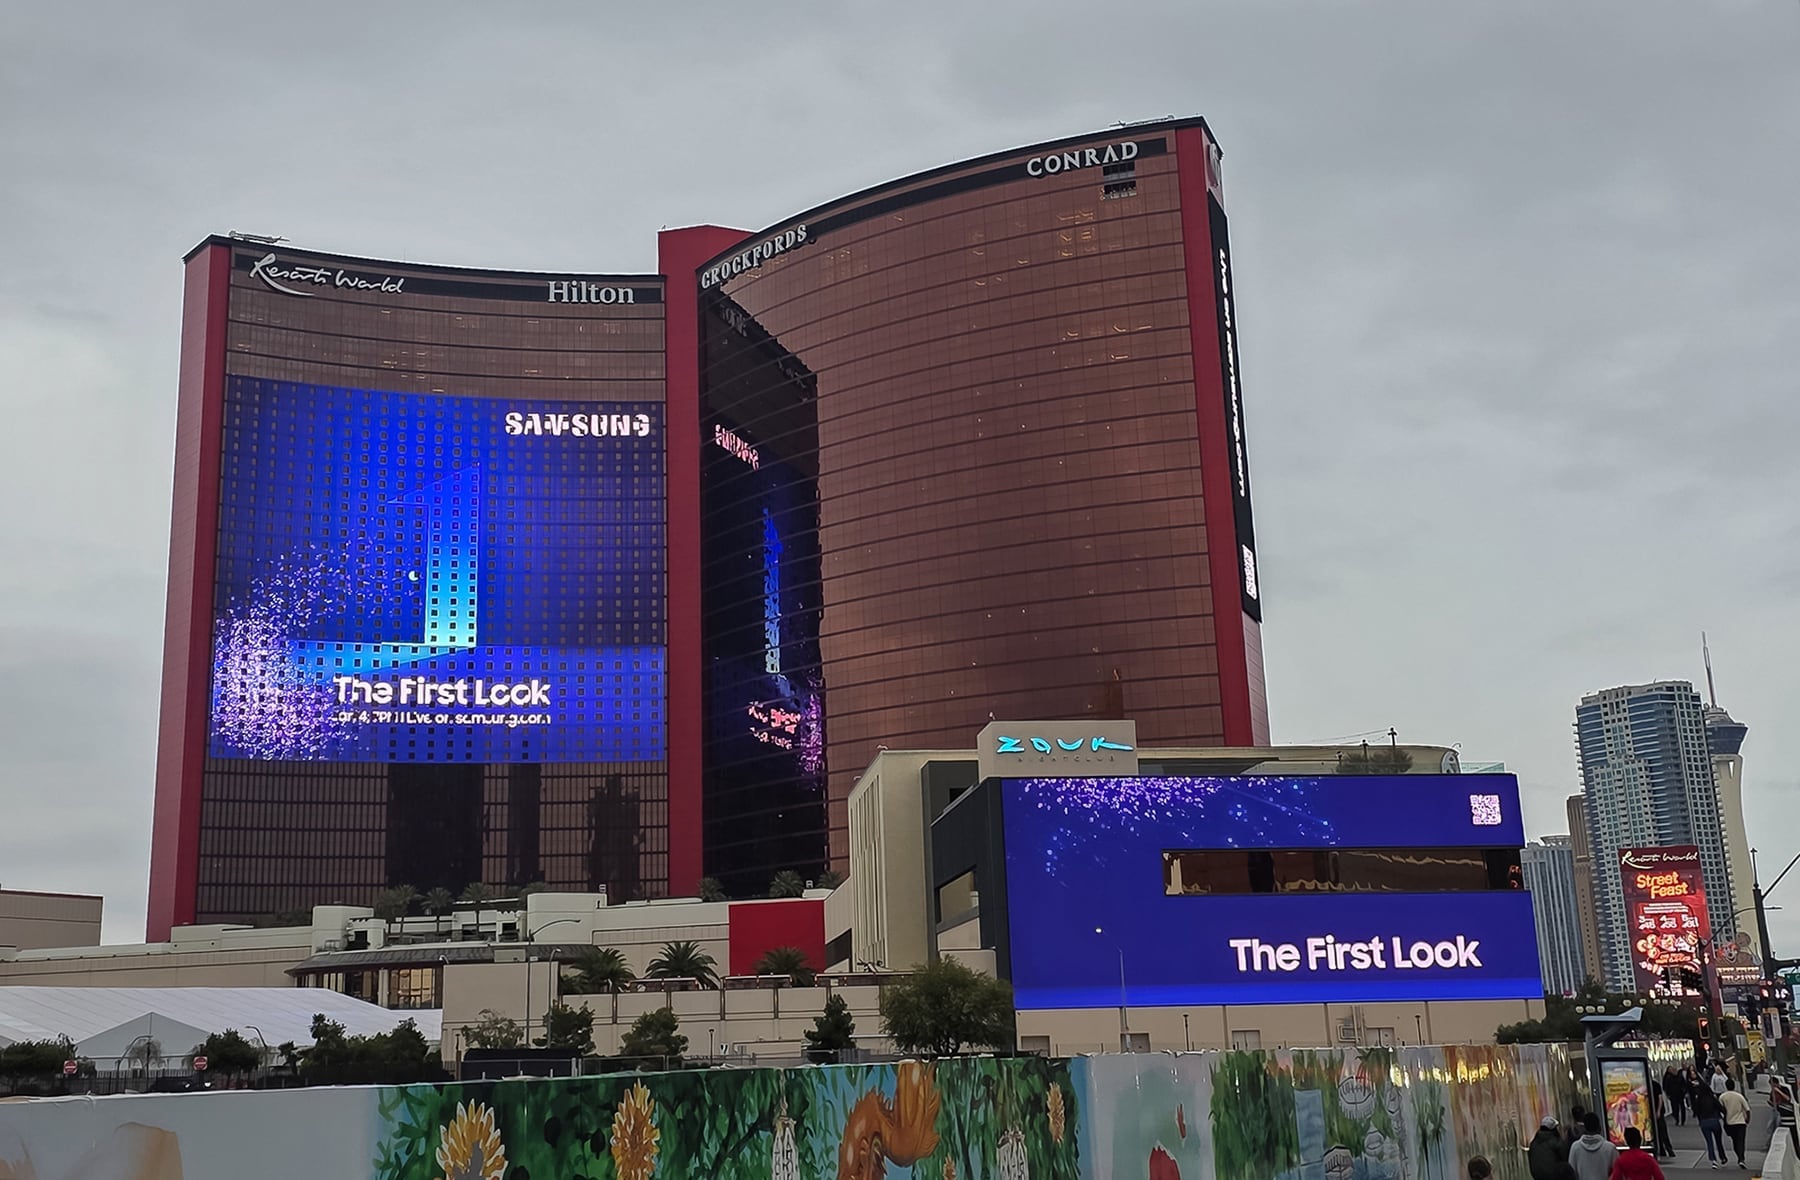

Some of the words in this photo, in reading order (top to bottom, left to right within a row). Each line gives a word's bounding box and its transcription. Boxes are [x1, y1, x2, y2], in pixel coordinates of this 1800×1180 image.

[1027, 141, 1138, 176] CONRAD
[701, 224, 808, 289] CROCKFORDS
[249, 253, 332, 296] Resorts
[335, 269, 405, 293] World
[548, 280, 635, 304] Hilton
[505, 411, 650, 437] SAMSUNG
[333, 676, 393, 704] The
[400, 676, 468, 705] First
[475, 679, 551, 705] Look
[997, 736, 1134, 754] ZOUK
[1636, 871, 1679, 889] Street
[1650, 881, 1688, 899] Feast
[1229, 938, 1300, 972] The
[1306, 934, 1386, 970] First
[1392, 935, 1483, 969] Look
